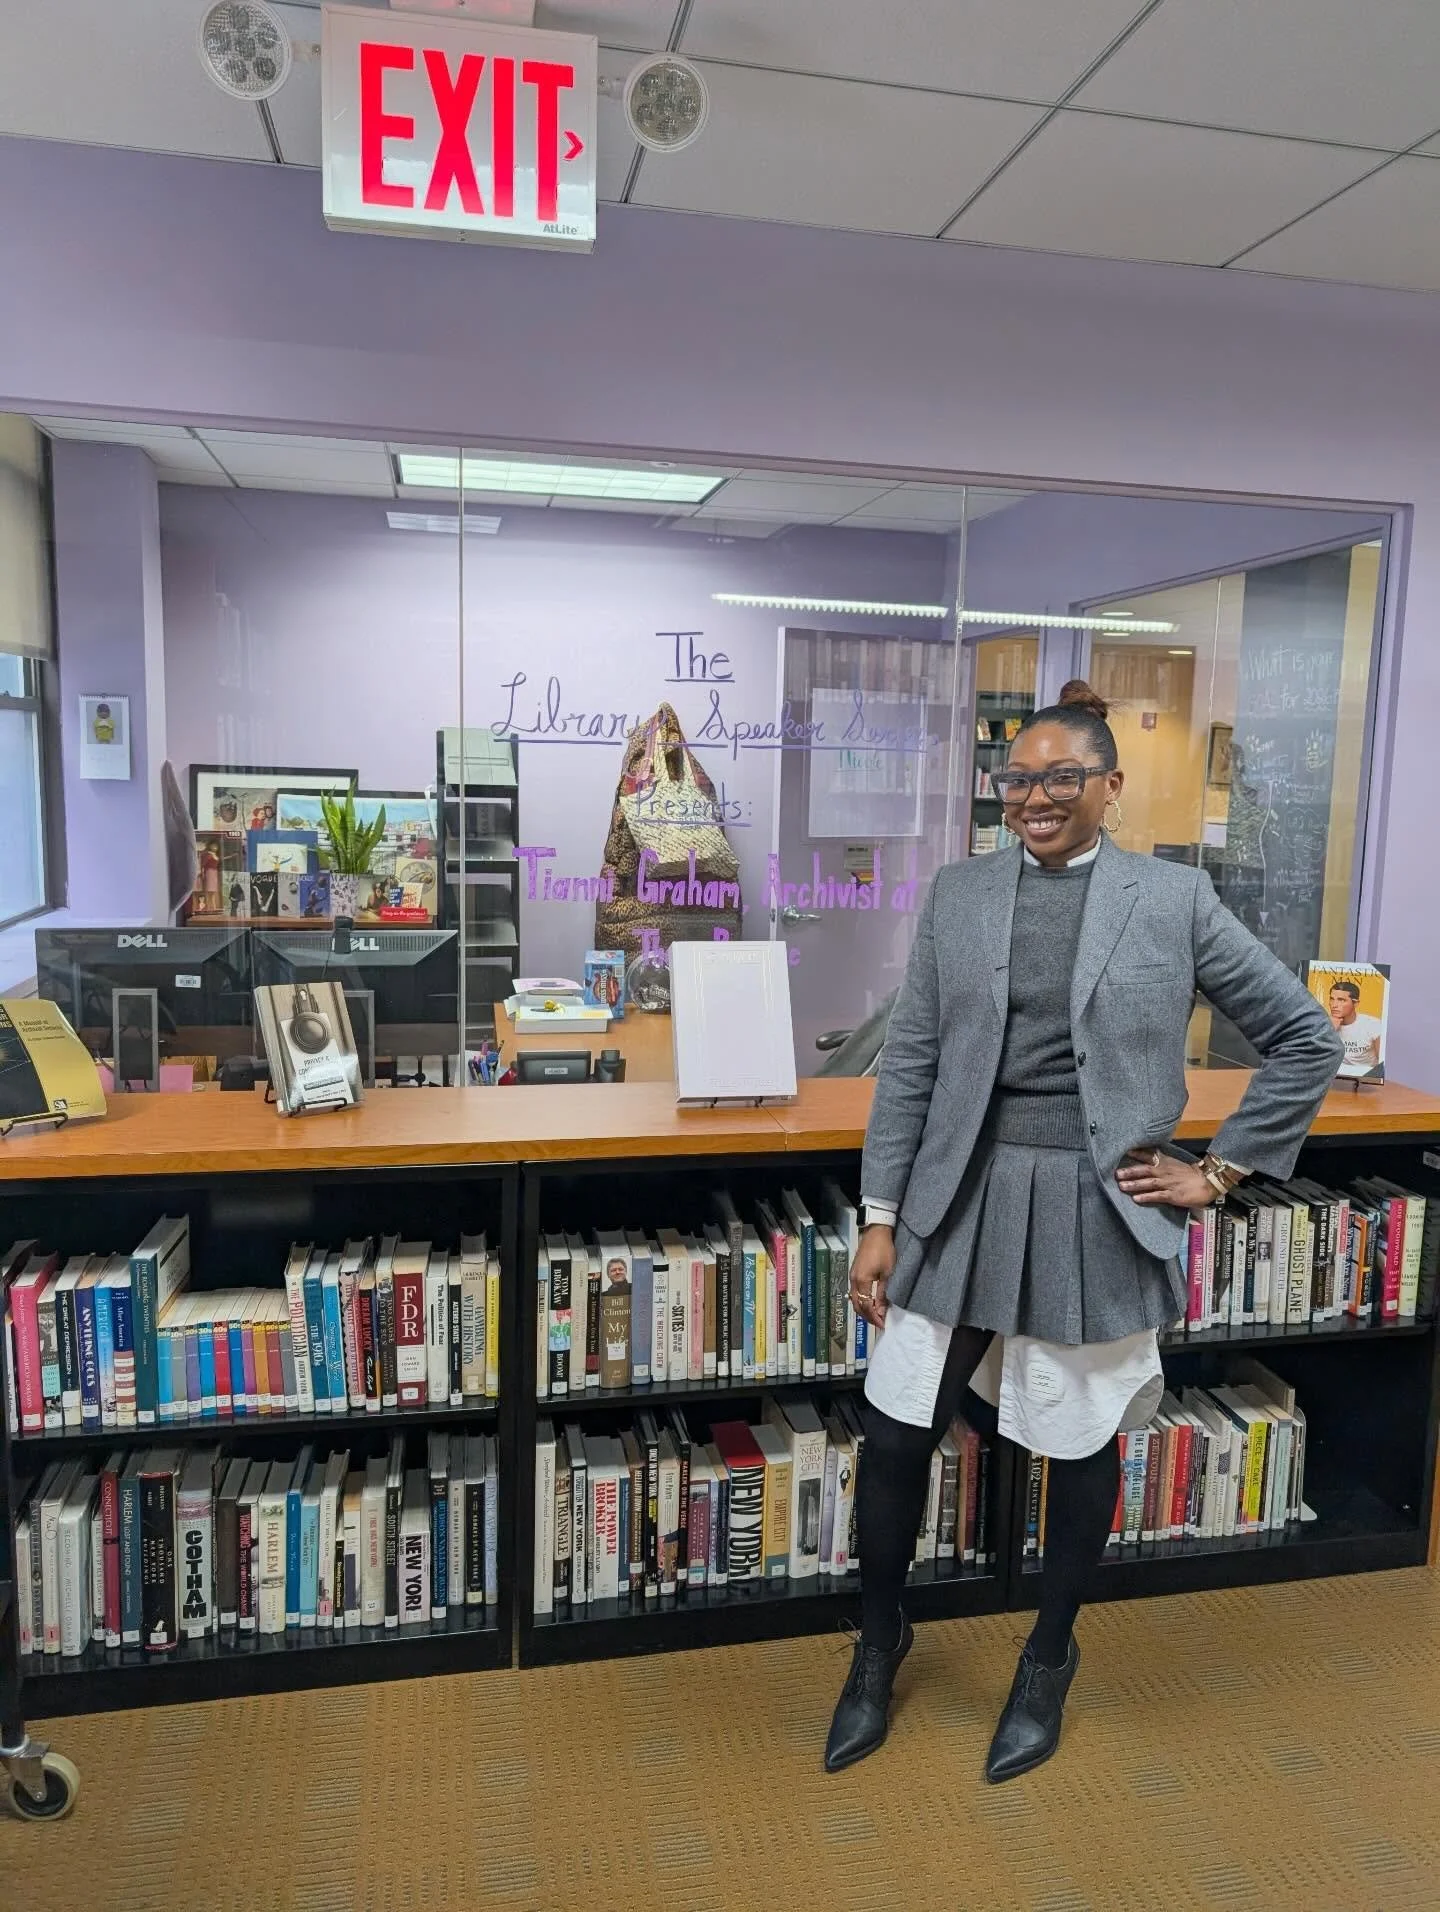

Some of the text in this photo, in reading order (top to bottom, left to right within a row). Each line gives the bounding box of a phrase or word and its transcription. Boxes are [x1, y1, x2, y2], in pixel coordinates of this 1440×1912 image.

[360, 41, 575, 222] EXIT
[543, 224, 578, 236] AtLite
[655, 631, 733, 680] The
[490, 672, 667, 745] Library
[696, 689, 826, 760] Speaker
[636, 780, 752, 820] Presents:
[763, 844, 883, 912] Archivist
[118, 934, 168, 949] DELL
[1319, 1207, 1328, 1221] THE
[1246, 1239, 1256, 1251] My
[1319, 1222, 1328, 1241] DARK
[1346, 1227, 1354, 1246] Who
[1393, 1221, 1401, 1266] WOODWARD
[141, 1263, 149, 1275] THE
[1193, 1253, 1202, 1285] AMERICA
[1247, 1253, 1255, 1270] Turn
[1277, 1223, 1288, 1290] GROUND TRUTH
[141, 1276, 150, 1303] ROARING
[553, 1269, 562, 1305] BROKAW
[561, 1276, 569, 1296] TOM
[744, 1269, 755, 1290] Seen
[1289, 1239, 1306, 1314] GHOST PLANE
[291, 1288, 301, 1300] THE
[463, 1294, 474, 1321] WITH
[611, 1298, 624, 1306] Bill
[744, 1300, 755, 1316] TV
[62, 1307, 70, 1330] GREAT
[143, 1304, 151, 1334] TWENTIES
[361, 1297, 371, 1325] DREAM
[401, 1285, 419, 1338] FDR
[603, 1308, 631, 1317] Clinton
[656, 1307, 664, 1318] THE
[671, 1305, 685, 1333] SIXTIES
[835, 1307, 845, 1332] 1950s
[82, 1306, 94, 1358] ANYTHING
[117, 1323, 125, 1348] America
[289, 1301, 309, 1358] POLITICIAN
[452, 1324, 460, 1344] STATES
[474, 1306, 485, 1356] GAMBLING
[607, 1322, 628, 1336] My
[64, 1332, 72, 1375] DEPRESSION
[312, 1341, 324, 1367] 1910s
[463, 1325, 474, 1368] HISTORY
[655, 1352, 664, 1369] CREW
[86, 1360, 96, 1387] GOES
[556, 1353, 564, 1378] BOOM!
[800, 1454, 823, 1464] YORK
[801, 1446, 822, 1455] NEW
[1131, 1433, 1145, 1500] THE GREAT DELUGE
[1149, 1438, 1160, 1484] ZEITOUN
[1252, 1435, 1263, 1487] PIECE CAKE
[648, 1448, 658, 1498] ONLY NEW YORK
[681, 1461, 689, 1485] HARLEM
[800, 1462, 821, 1472] CITY
[633, 1470, 643, 1512] HELLUVA TOWN
[681, 1486, 688, 1496] ON
[730, 1467, 765, 1516] NEW
[1030, 1462, 1041, 1522] 102 MINUTES
[103, 1481, 113, 1536] CONNECTICUT
[437, 1501, 448, 1535] HUDSON
[576, 1504, 584, 1527] NEW
[595, 1482, 606, 1537] BROKER
[606, 1479, 617, 1556] THE POWER
[773, 1499, 788, 1544] EMPIRE CITY
[122, 1489, 133, 1576] HARLEM LOST AND FOUND
[386, 1514, 396, 1566] SOUTH STREET
[557, 1496, 569, 1556] TRIANGLE
[576, 1528, 584, 1553] YORK
[63, 1529, 73, 1569] BECOMING
[266, 1522, 279, 1574] HARLEM
[405, 1535, 422, 1571] NEW
[438, 1537, 448, 1575] VALLEY
[183, 1529, 207, 1619] GOTHAM
[239, 1513, 251, 1617] WATCHING THE WORLD CHANGE
